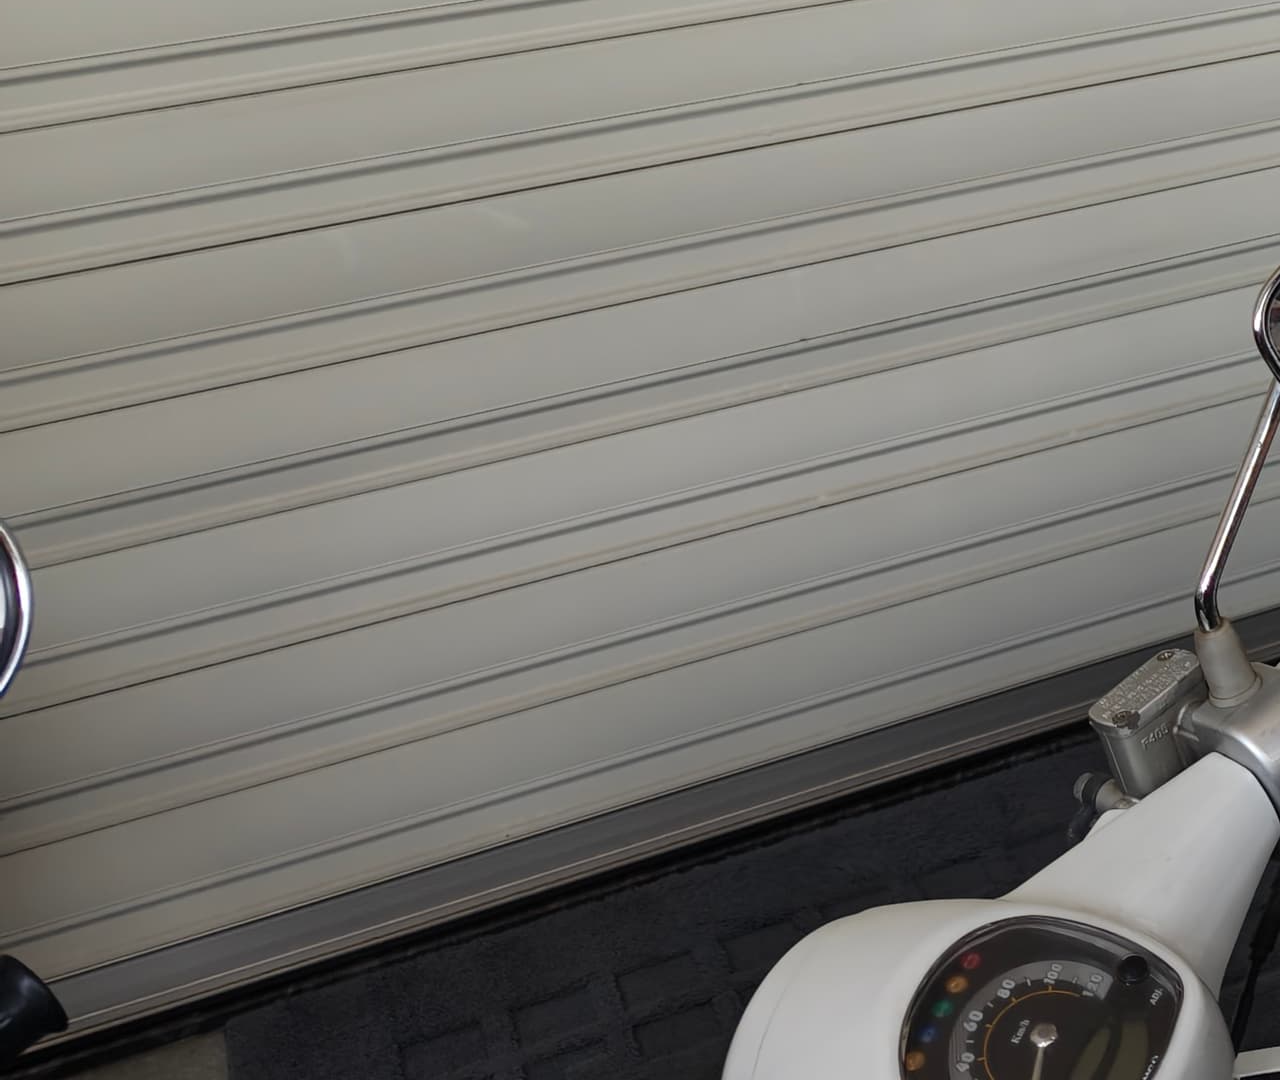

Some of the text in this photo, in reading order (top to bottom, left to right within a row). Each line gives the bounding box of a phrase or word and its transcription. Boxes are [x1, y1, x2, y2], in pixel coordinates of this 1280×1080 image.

[1043, 963, 1063, 985] 100
[997, 979, 1016, 999] 80
[1082, 974, 1103, 997] 120
[963, 1010, 984, 1032] 60
[1011, 1019, 1031, 1044] Km/h
[956, 1052, 975, 1073] 40
